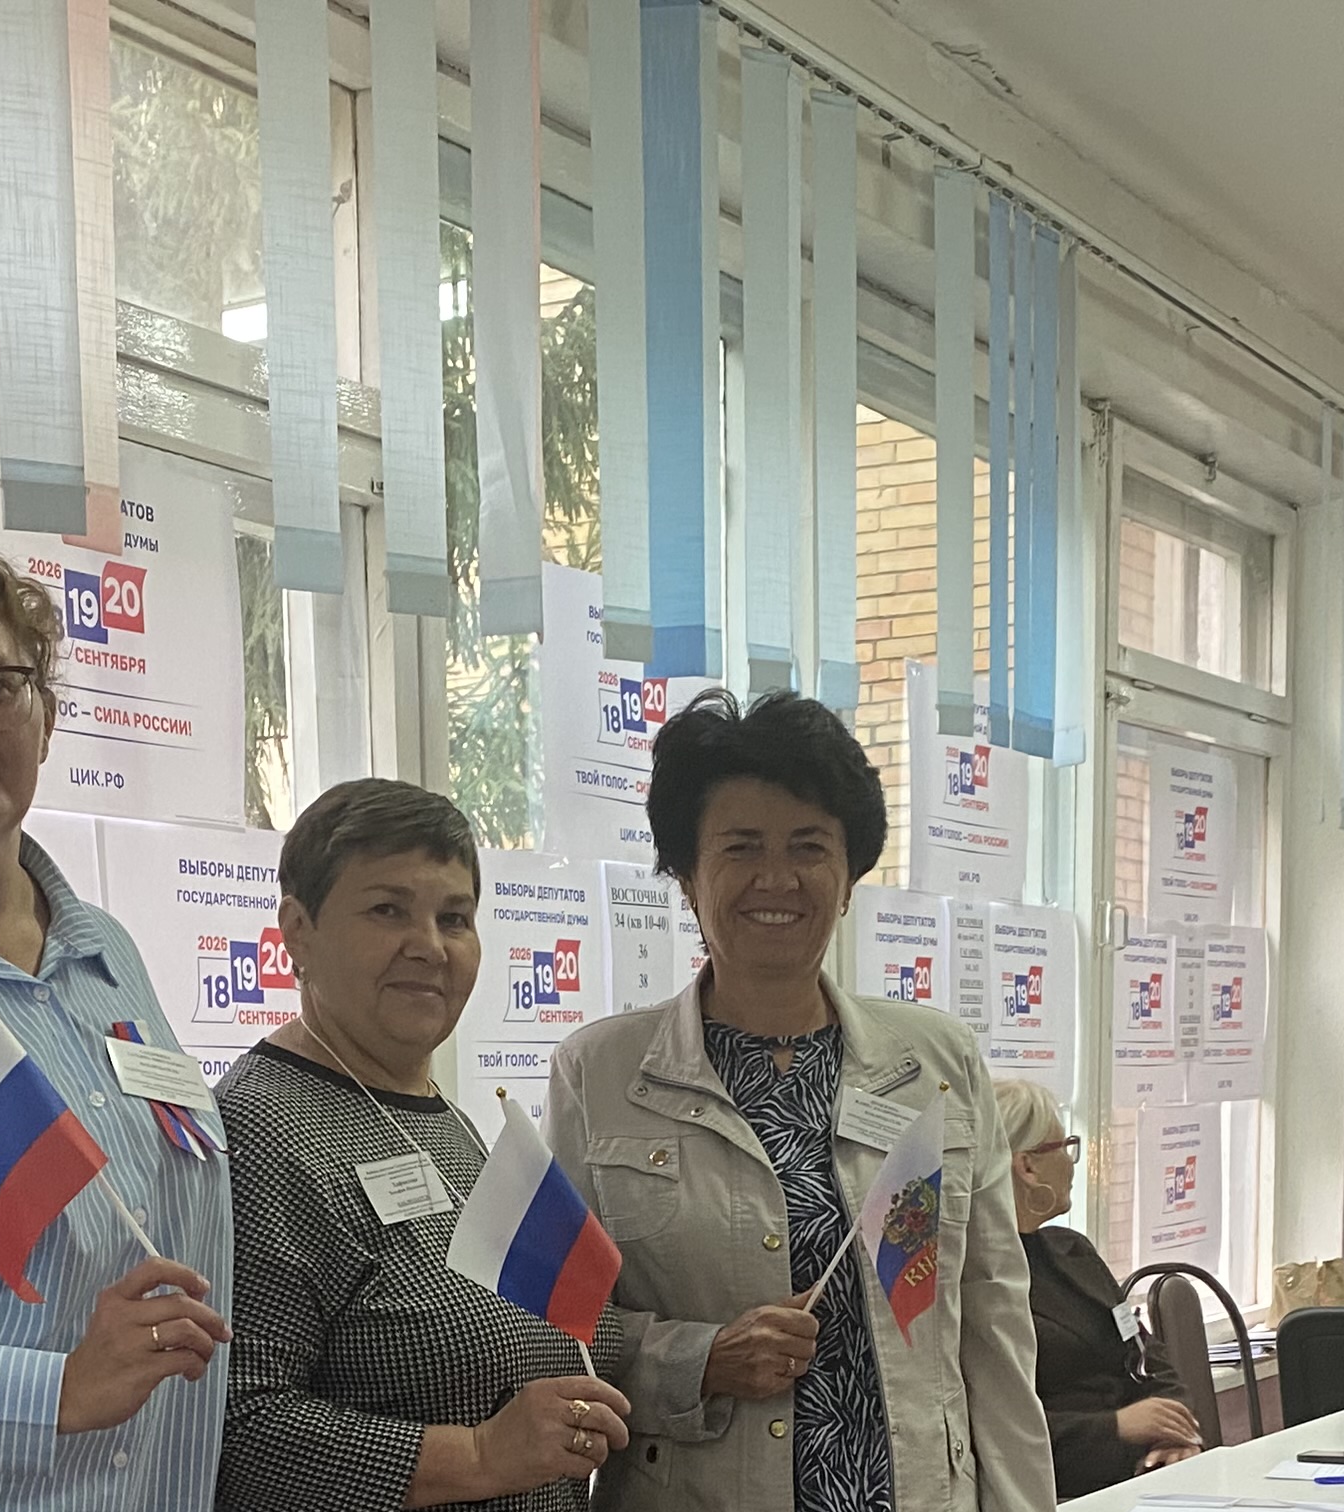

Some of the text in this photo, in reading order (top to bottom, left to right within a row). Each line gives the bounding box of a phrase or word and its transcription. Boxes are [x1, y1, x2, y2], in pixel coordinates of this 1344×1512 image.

[124, 532, 159, 552] ДУМЫ
[28, 558, 62, 579] 2026
[68, 588, 98, 628] 19
[104, 577, 140, 618] 20
[75, 647, 147, 674] СЕНТЯБРЯ
[623, 692, 641, 721] 19
[644, 681, 665, 712] 20
[94, 706, 131, 727] СИЛА
[133, 713, 193, 736] РОССИИ!
[603, 704, 621, 733] 18
[961, 763, 973, 786] 19
[974, 754, 988, 778] 20
[69, 767, 125, 790] ЦИК.РФ
[948, 773, 960, 796] 18
[179, 859, 234, 879] ВЫБОРЫ
[177, 889, 278, 911] ГОСУДАРСТВЕННОЙ
[495, 882, 586, 902] ВЫБОРЫ ДЕПУТАТОВ
[611, 887, 669, 905] ВОСТОЧНАЯ
[494, 908, 566, 924] ГОСУДАРСТВЕННОЙ
[198, 936, 228, 952] 2026
[509, 947, 532, 961] 2026
[638, 944, 648, 959] 36
[261, 941, 293, 976] 20
[556, 951, 578, 980] 20
[233, 956, 256, 992] 19
[536, 965, 554, 994] 19
[639, 974, 648, 989] 38
[916, 967, 930, 989] 20
[1028, 975, 1041, 996] 20
[203, 975, 231, 1009] 18
[513, 981, 533, 1010] 18
[902, 977, 914, 1000] 19
[1016, 984, 1027, 1006] 19
[539, 1010, 584, 1023] СЕНТЯБРЯ
[1004, 996, 1016, 1017] 18
[478, 1051, 503, 1067] ТВОЙ
[505, 1053, 539, 1067] ГОЛОС
